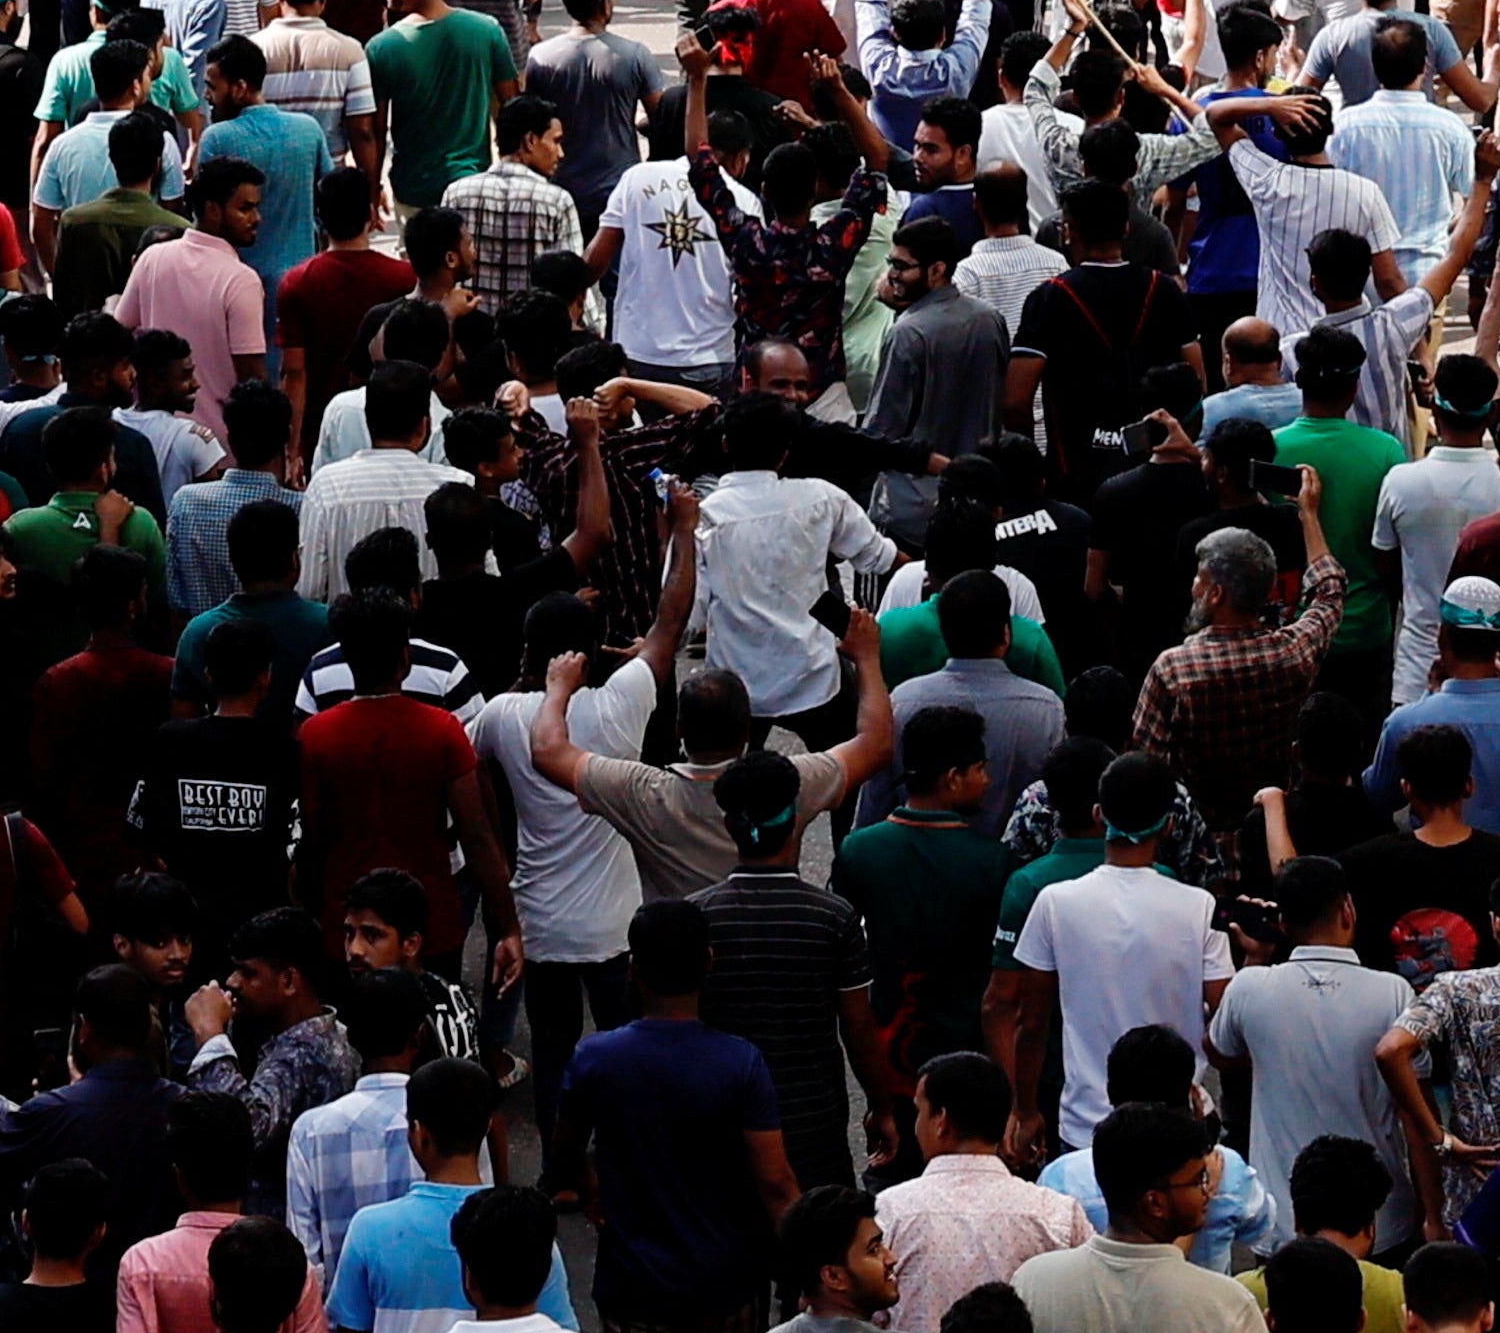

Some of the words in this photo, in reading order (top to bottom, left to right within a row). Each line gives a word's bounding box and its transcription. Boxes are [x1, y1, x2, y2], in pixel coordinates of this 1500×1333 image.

[183, 783, 223, 805] BEST
[228, 787, 265, 808] BOY
[217, 806, 264, 827] EVER!
